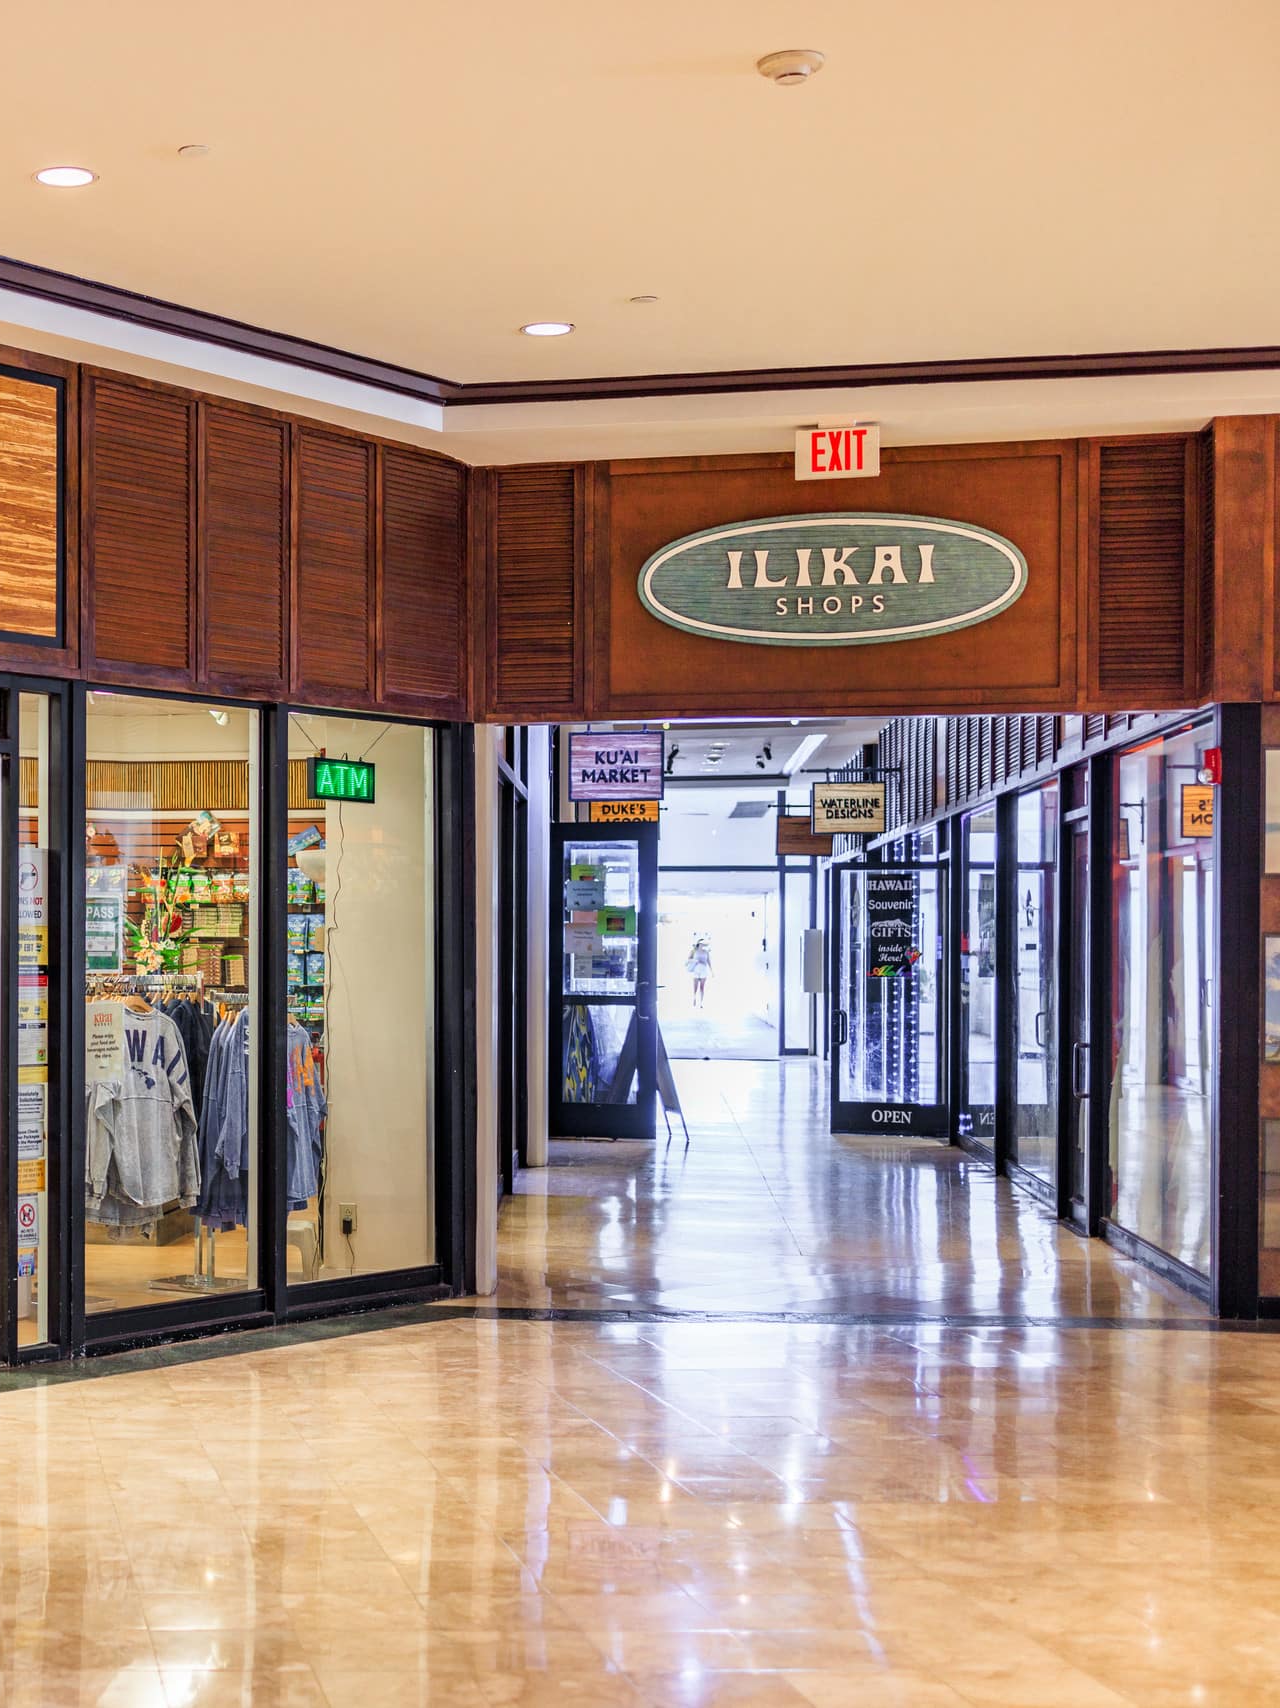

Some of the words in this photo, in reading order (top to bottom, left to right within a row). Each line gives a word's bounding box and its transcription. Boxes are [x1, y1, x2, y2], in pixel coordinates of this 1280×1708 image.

[811, 429, 868, 473] EXIT
[727, 544, 936, 589] ILIKAI
[776, 595, 886, 616] SHOPS
[594, 750, 639, 765] KU'AI
[320, 764, 368, 797] ATM
[581, 769, 651, 783] MARKET
[601, 804, 646, 815] DUKE'S
[820, 798, 881, 809] WATERLINE
[826, 809, 874, 819] DESIGNS
[868, 899, 913, 910] Souvenir
[86, 906, 114, 919] PASS
[871, 927, 912, 937] GIFTS
[871, 1109, 913, 1125] OPEN
